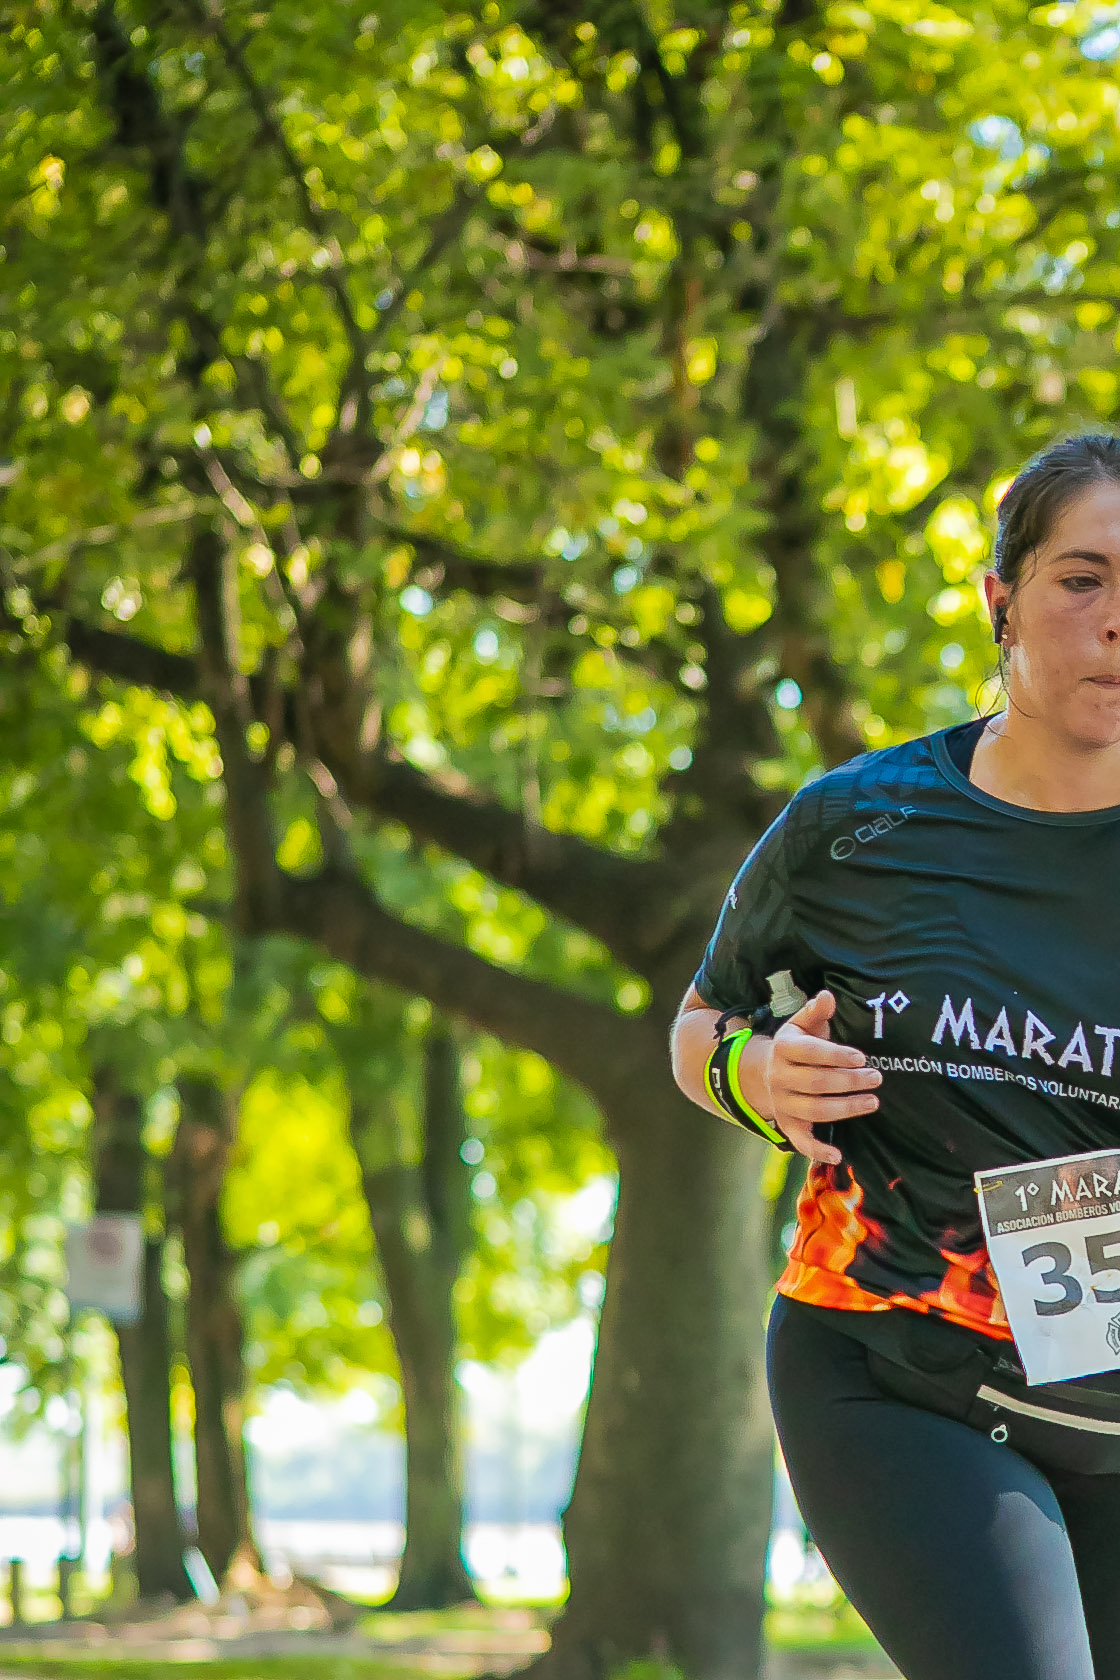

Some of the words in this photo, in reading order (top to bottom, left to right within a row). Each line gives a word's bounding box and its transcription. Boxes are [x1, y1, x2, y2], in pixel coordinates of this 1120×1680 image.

[865, 1056, 943, 1075] SOCIACIÓN
[946, 1062, 1038, 1091] BOMBEROS
[1055, 1203, 1109, 1224] BOMBEROS
